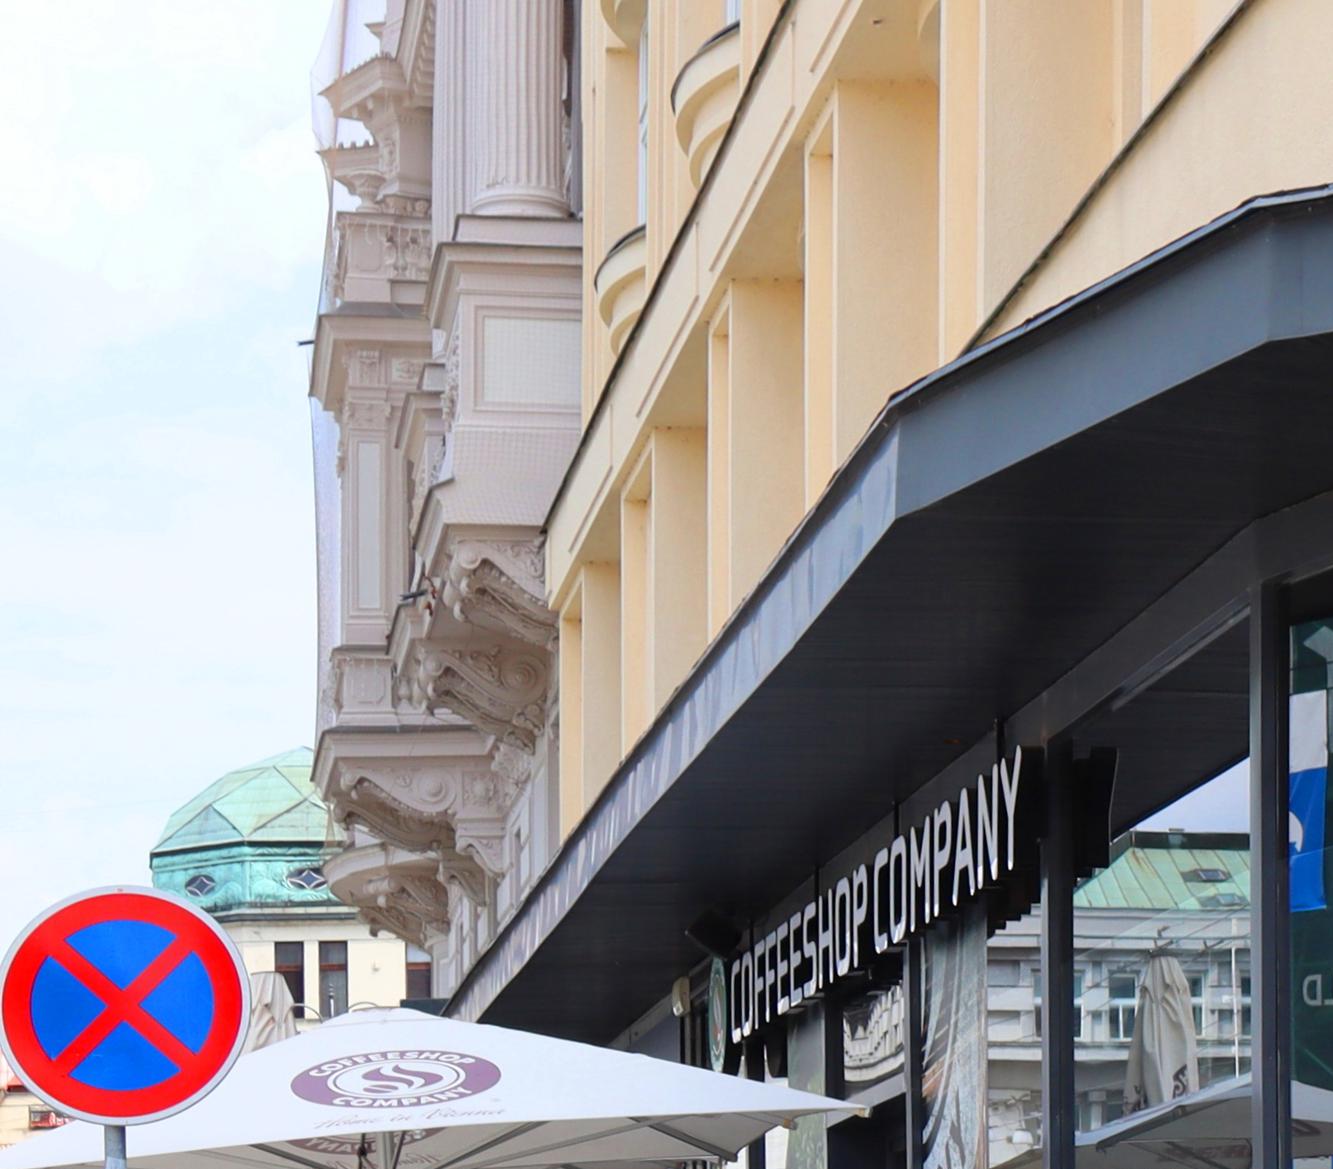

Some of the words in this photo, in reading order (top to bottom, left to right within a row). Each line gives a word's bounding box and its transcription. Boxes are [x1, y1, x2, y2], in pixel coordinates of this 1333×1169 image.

[730, 863, 868, 1044] COFFEESHOP
[873, 744, 1022, 954] COMPANY
[308, 1051, 476, 1078] COFFEESHOP
[332, 1085, 473, 1108] COMPANY
